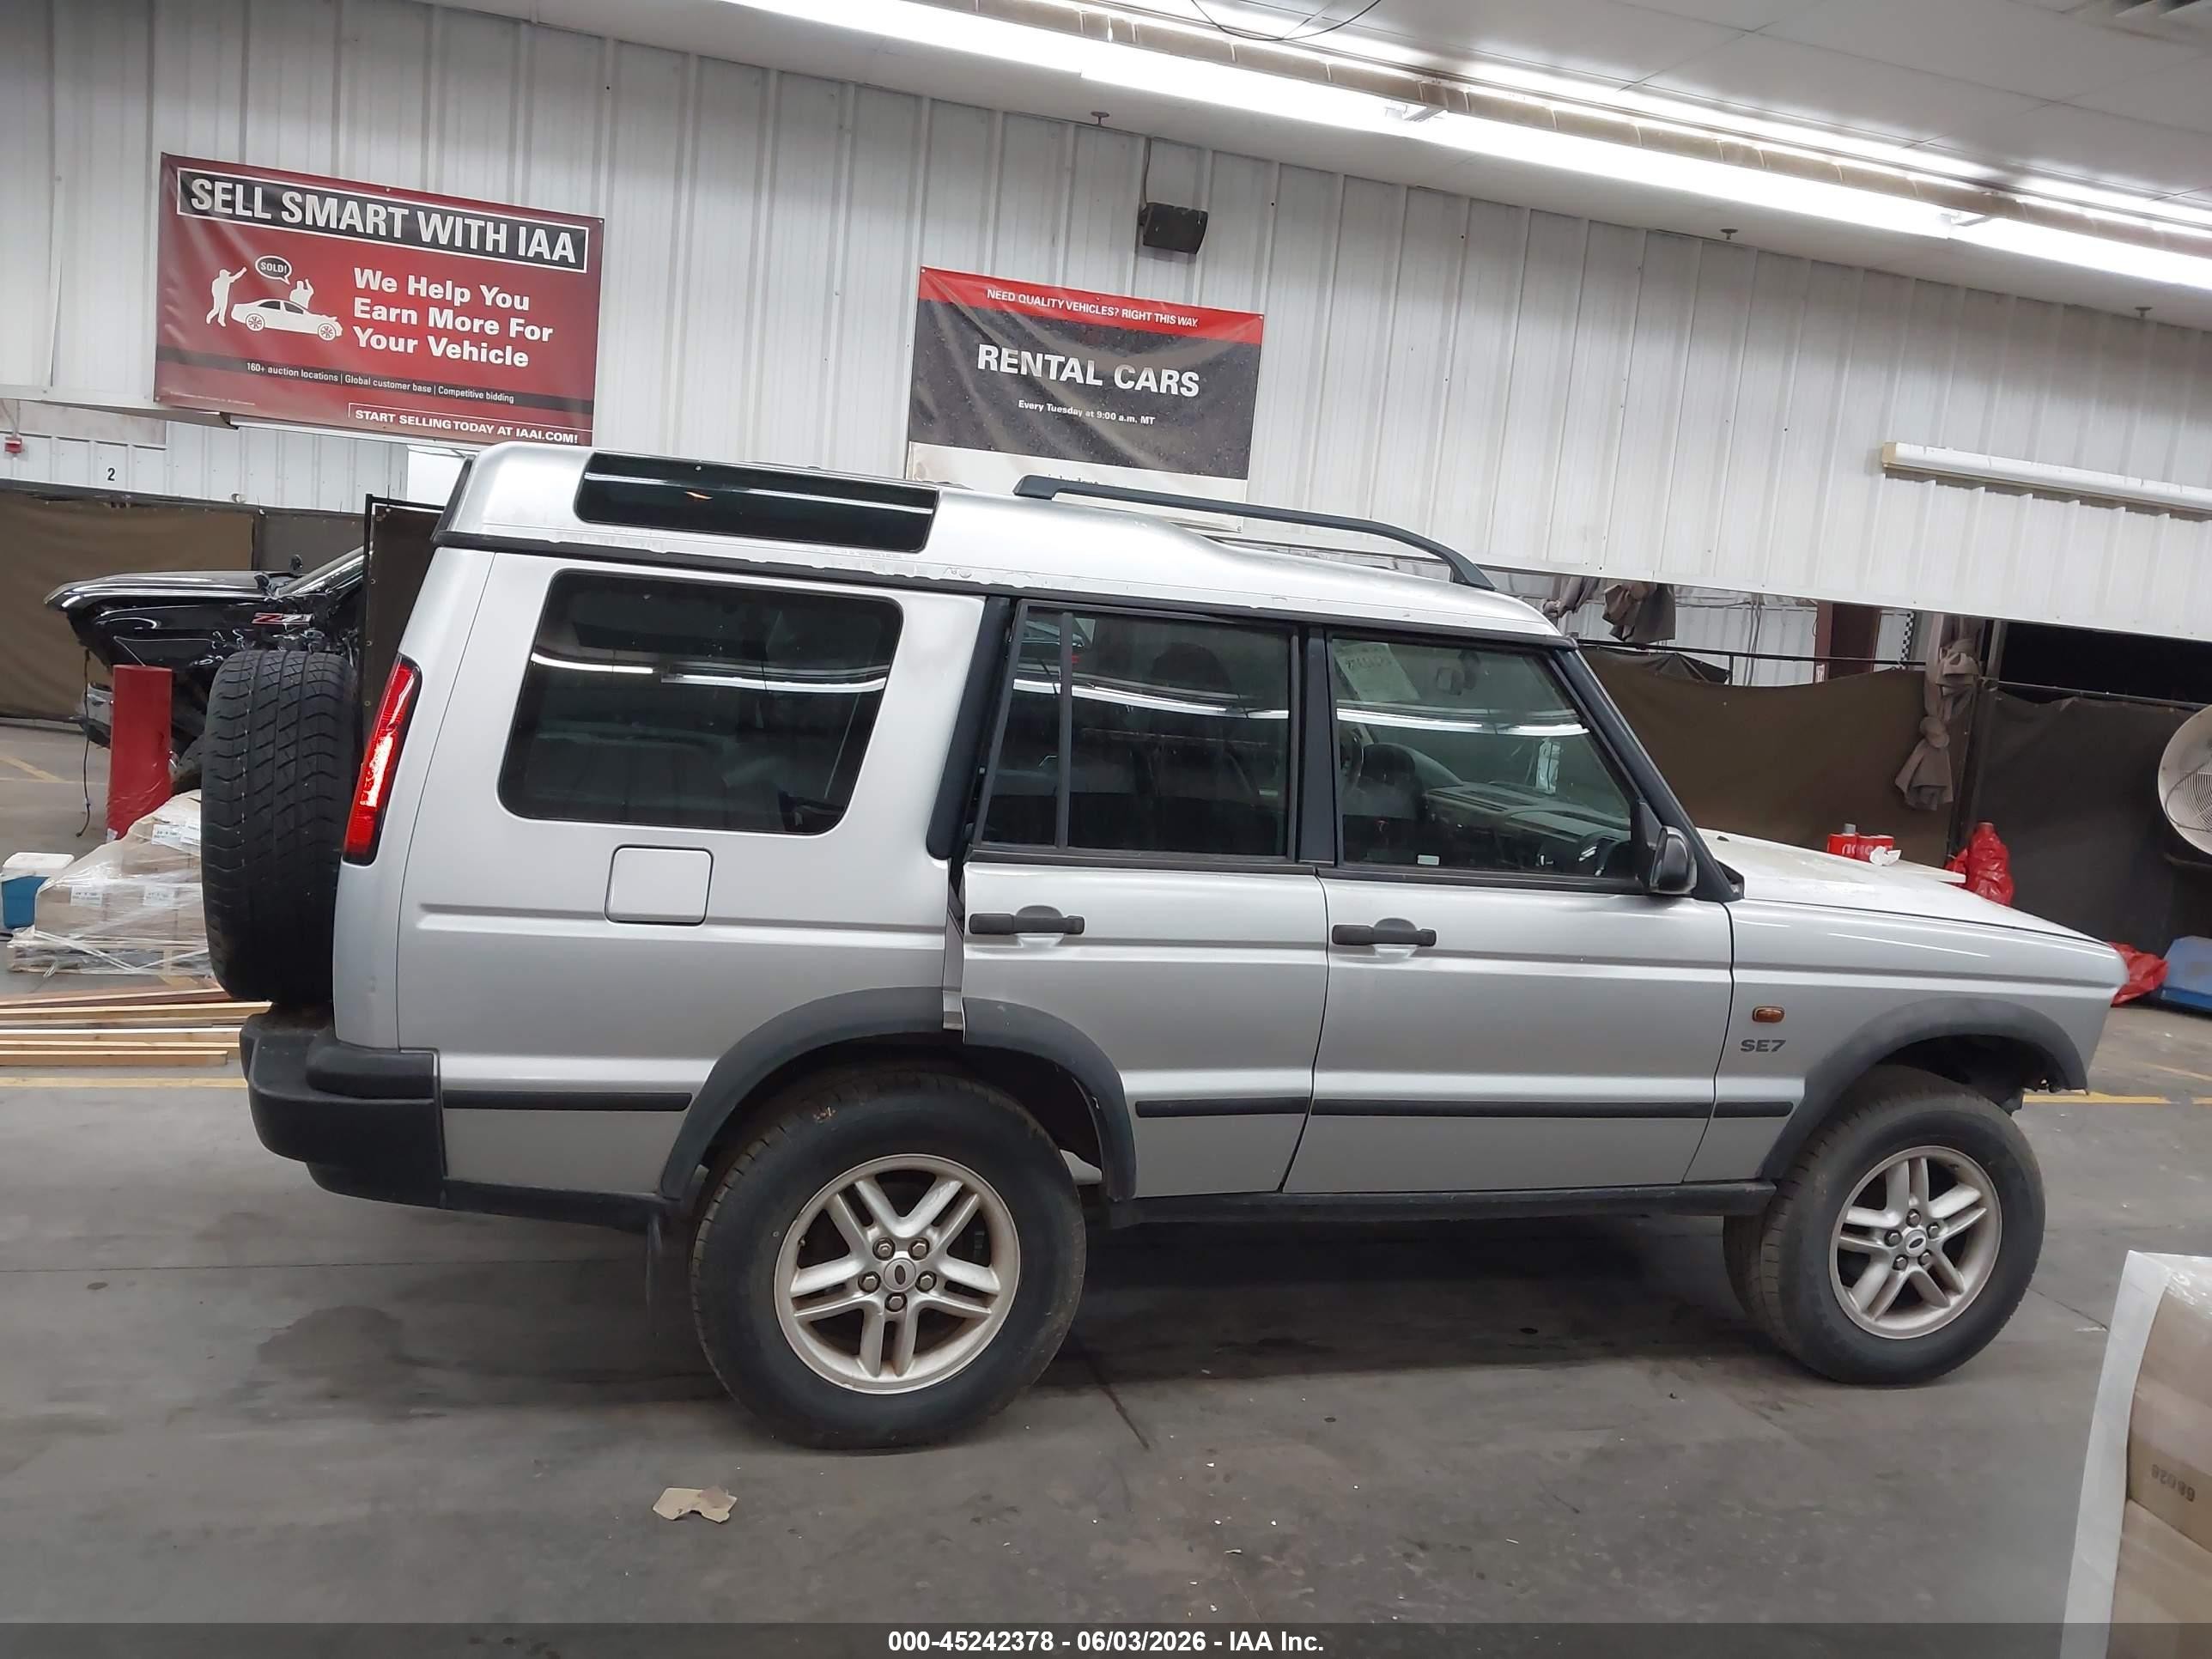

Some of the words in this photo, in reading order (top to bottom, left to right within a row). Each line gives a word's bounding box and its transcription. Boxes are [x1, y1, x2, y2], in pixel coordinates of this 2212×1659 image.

[191, 178, 271, 221] SELL
[281, 191, 409, 239] SMART
[416, 210, 507, 254] WITH
[517, 226, 576, 264] IAA
[260, 261, 287, 274] SOLD!
[354, 267, 398, 293] We
[407, 275, 471, 305] Help
[479, 284, 530, 311] You
[987, 289, 1016, 302] NEED
[1018, 293, 1064, 309] QUALITY
[1066, 299, 1120, 317] VEHICLES?
[1121, 308, 1152, 321] RIGHT
[1154, 313, 1176, 325] THIS
[354, 297, 418, 325] Earn
[428, 307, 501, 336] More
[509, 317, 554, 343] For
[352, 325, 419, 354] Your
[427, 336, 530, 368] Vehicle
[246, 362, 265, 373] 160+
[267, 368, 299, 377] auction
[301, 370, 338, 382] locations
[344, 375, 371, 386] Global
[373, 380, 410, 392] customer
[413, 383, 432, 393] base
[438, 386, 484, 400] Competitive
[485, 392, 514, 404] bidding
[977, 343, 1103, 386] RENTAL
[1114, 364, 1200, 398] CARS
[355, 410, 396, 423] START
[398, 415, 452, 429] SELLING
[453, 421, 495, 434] TODAY
[497, 426, 513, 436] AT
[515, 428, 579, 444] IAAI.COM!
[1018, 400, 1044, 412] Every
[1047, 404, 1083, 417] Tuesday
[1085, 410, 1095, 418] at
[1097, 411, 1116, 421] 9:00
[1118, 416, 1138, 424] a.m.
[1140, 416, 1156, 425] MT
[107, 467, 116, 482] 2
[1740, 1039, 1786, 1053] SE7
